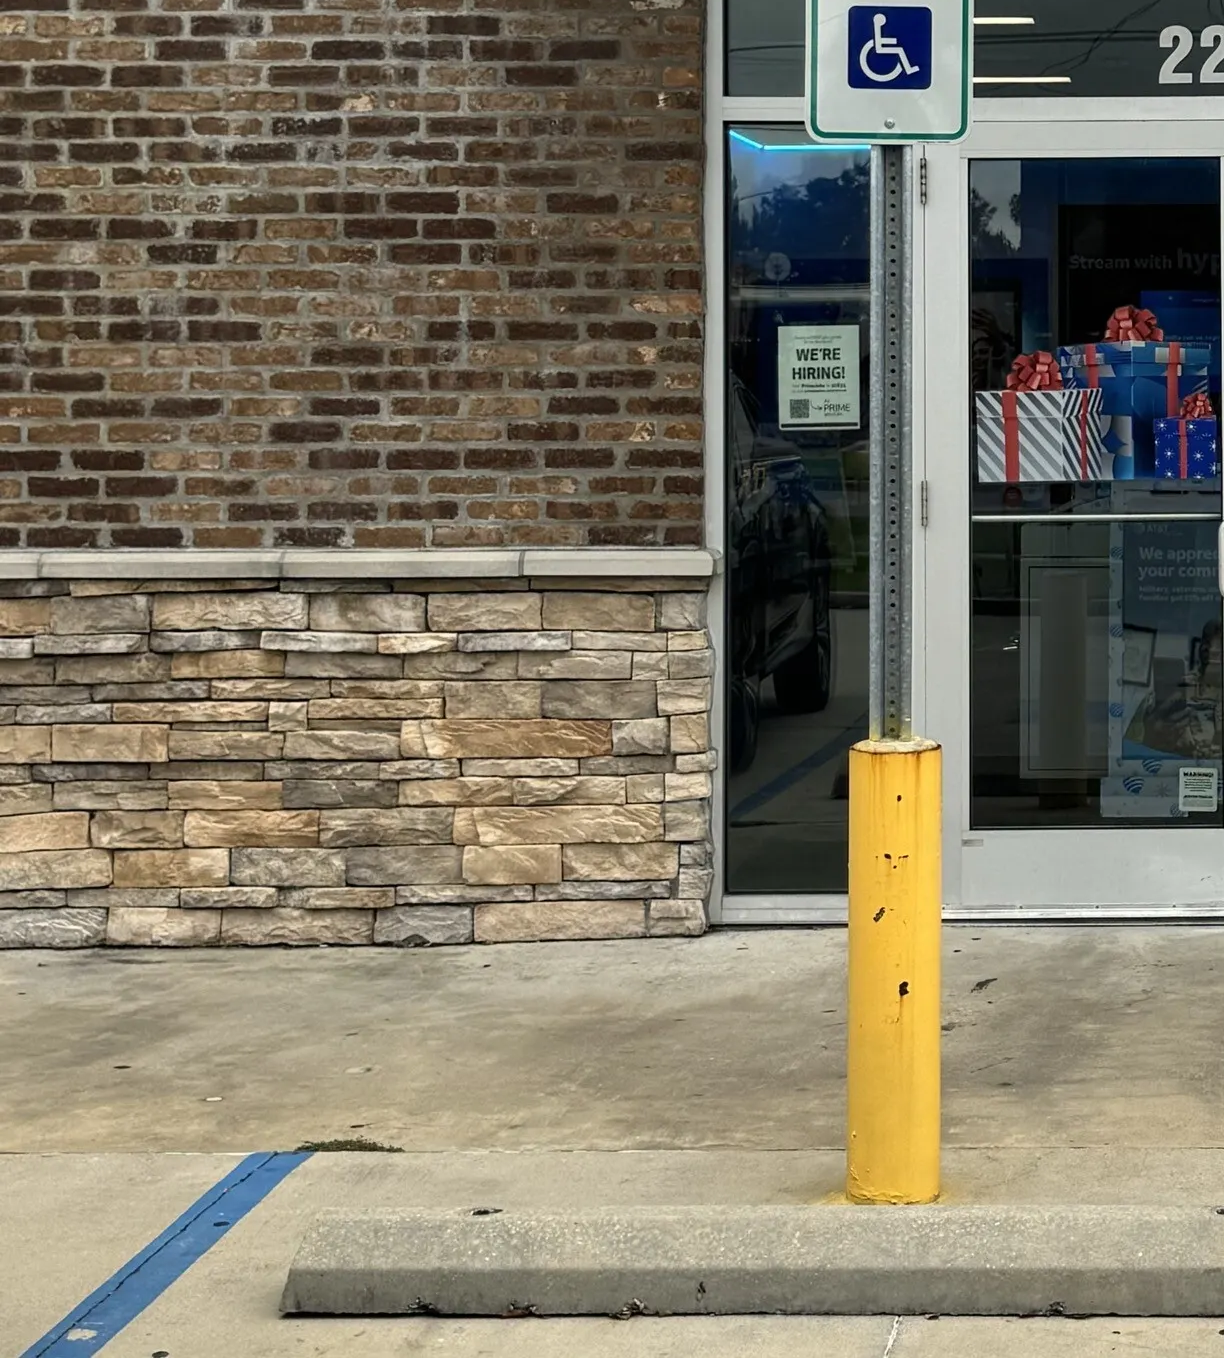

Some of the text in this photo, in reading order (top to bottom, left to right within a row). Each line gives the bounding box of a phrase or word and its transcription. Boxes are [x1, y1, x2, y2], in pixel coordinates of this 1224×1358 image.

[1068, 254, 1130, 269] Stream
[1134, 254, 1172, 269] with
[796, 348, 841, 361] WE'RE
[792, 367, 845, 380] HIRING!
[1139, 546, 1163, 560] We
[1138, 566, 1175, 581] your
